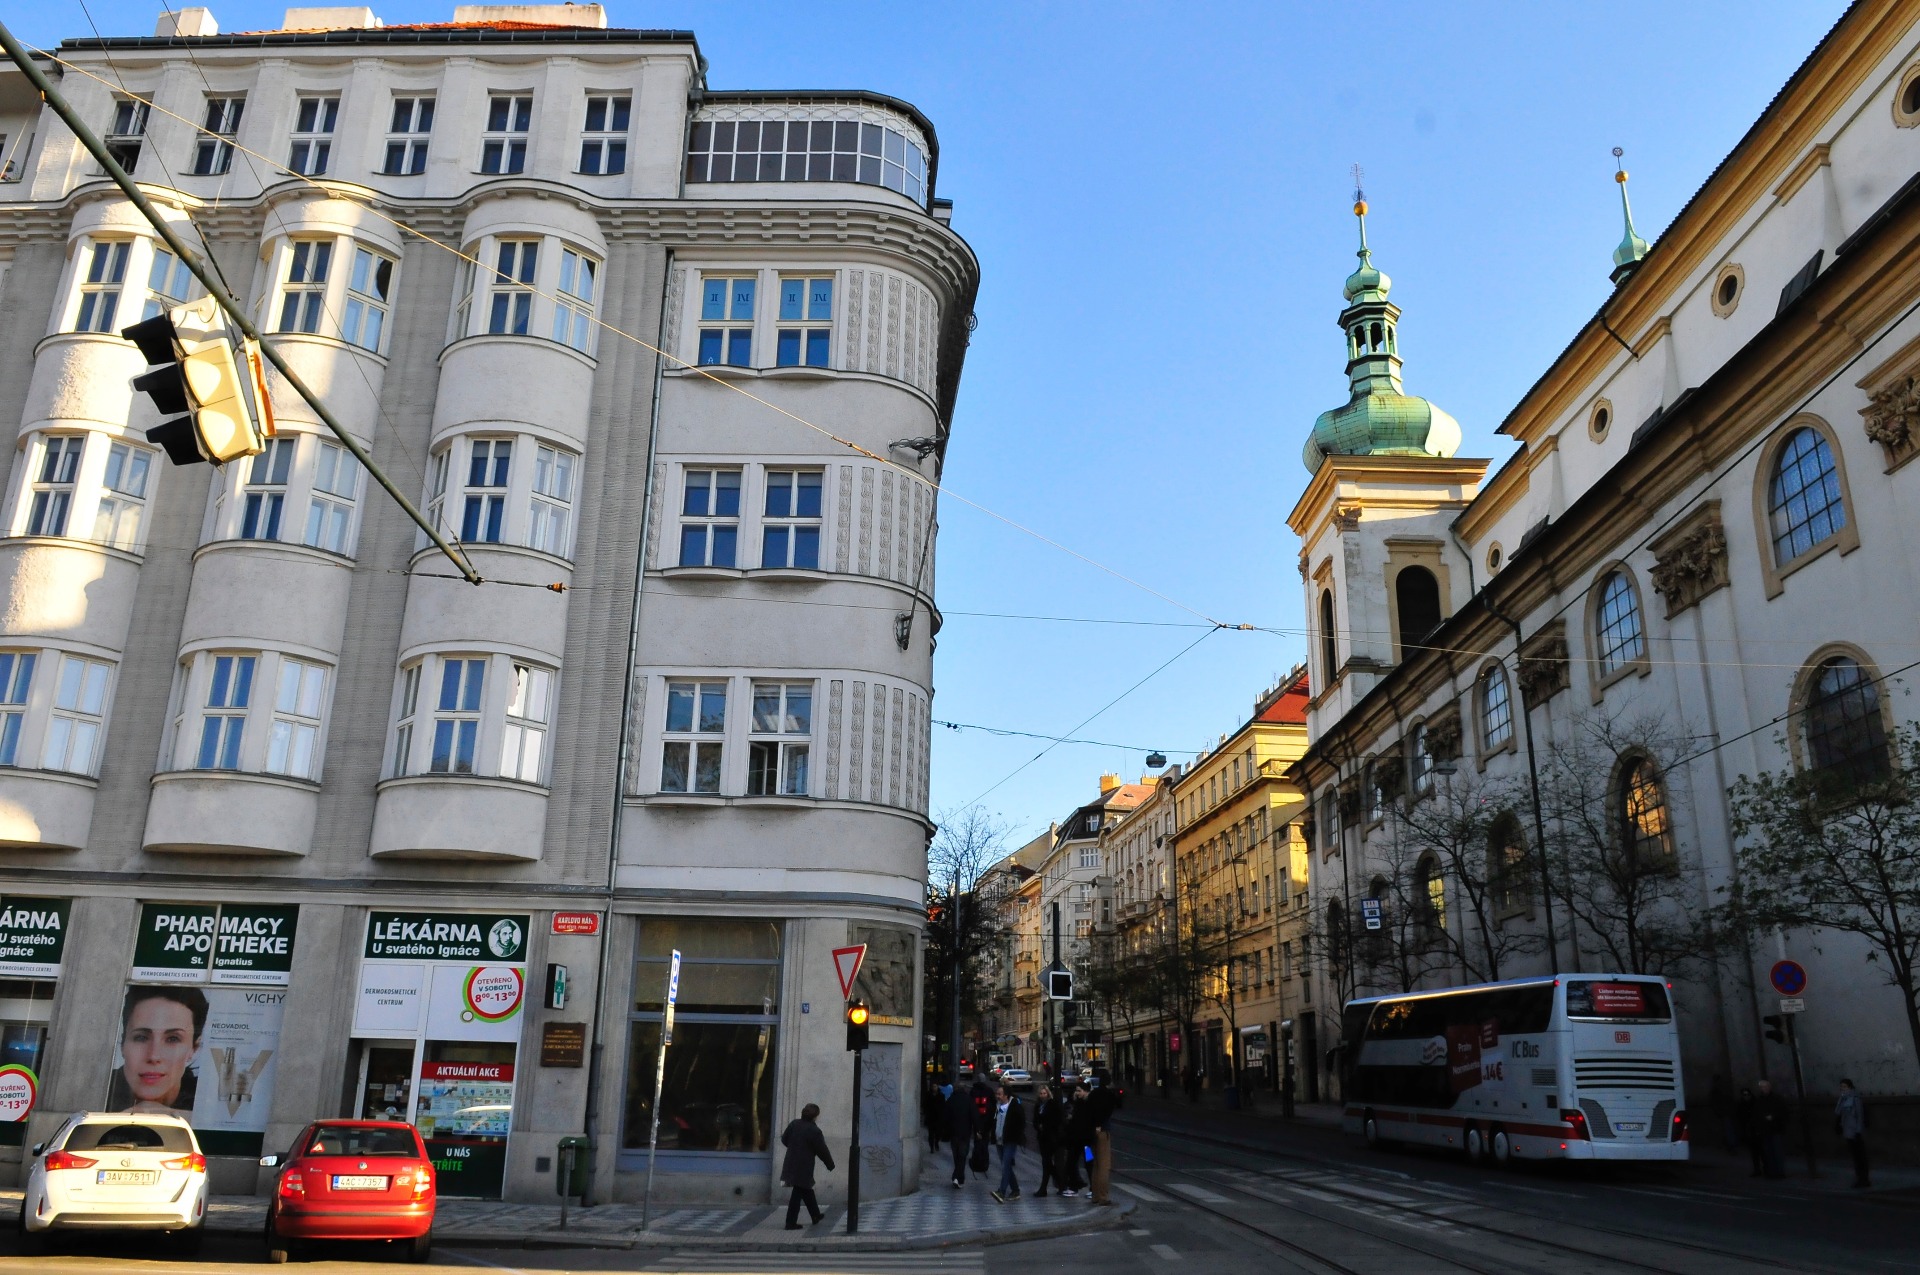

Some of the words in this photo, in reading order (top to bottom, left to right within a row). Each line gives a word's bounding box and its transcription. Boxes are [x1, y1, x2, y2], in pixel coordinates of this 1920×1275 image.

[0, 905, 60, 930] ÁRNA
[374, 918, 482, 943] LÉKÁRNA
[10, 933, 56, 945] svatého
[372, 943, 382, 954] U
[385, 943, 435, 955] svatého
[438, 944, 480, 958] Ignáce
[190, 956, 204, 965] St.
[215, 957, 253, 967] Ignatius
[477, 977, 512, 985] OTEVŘENO
[364, 988, 417, 996] DERMOKOSMETICKÉ
[245, 993, 286, 1004] VICHY
[1616, 1033, 1629, 1041] DB
[1512, 1040, 1521, 1058] IC
[1522, 1041, 1539, 1058] Bus
[437, 1066, 478, 1077] AKTUÁLNÍ
[479, 1067, 500, 1077] AKCE
[446, 1148, 453, 1157] U
[453, 1146, 471, 1158] NÁS
[106, 1172, 123, 1181] 3AV
[128, 1173, 150, 1181] 7511
[340, 1177, 356, 1187] 4AC
[362, 1177, 382, 1187] 7357
